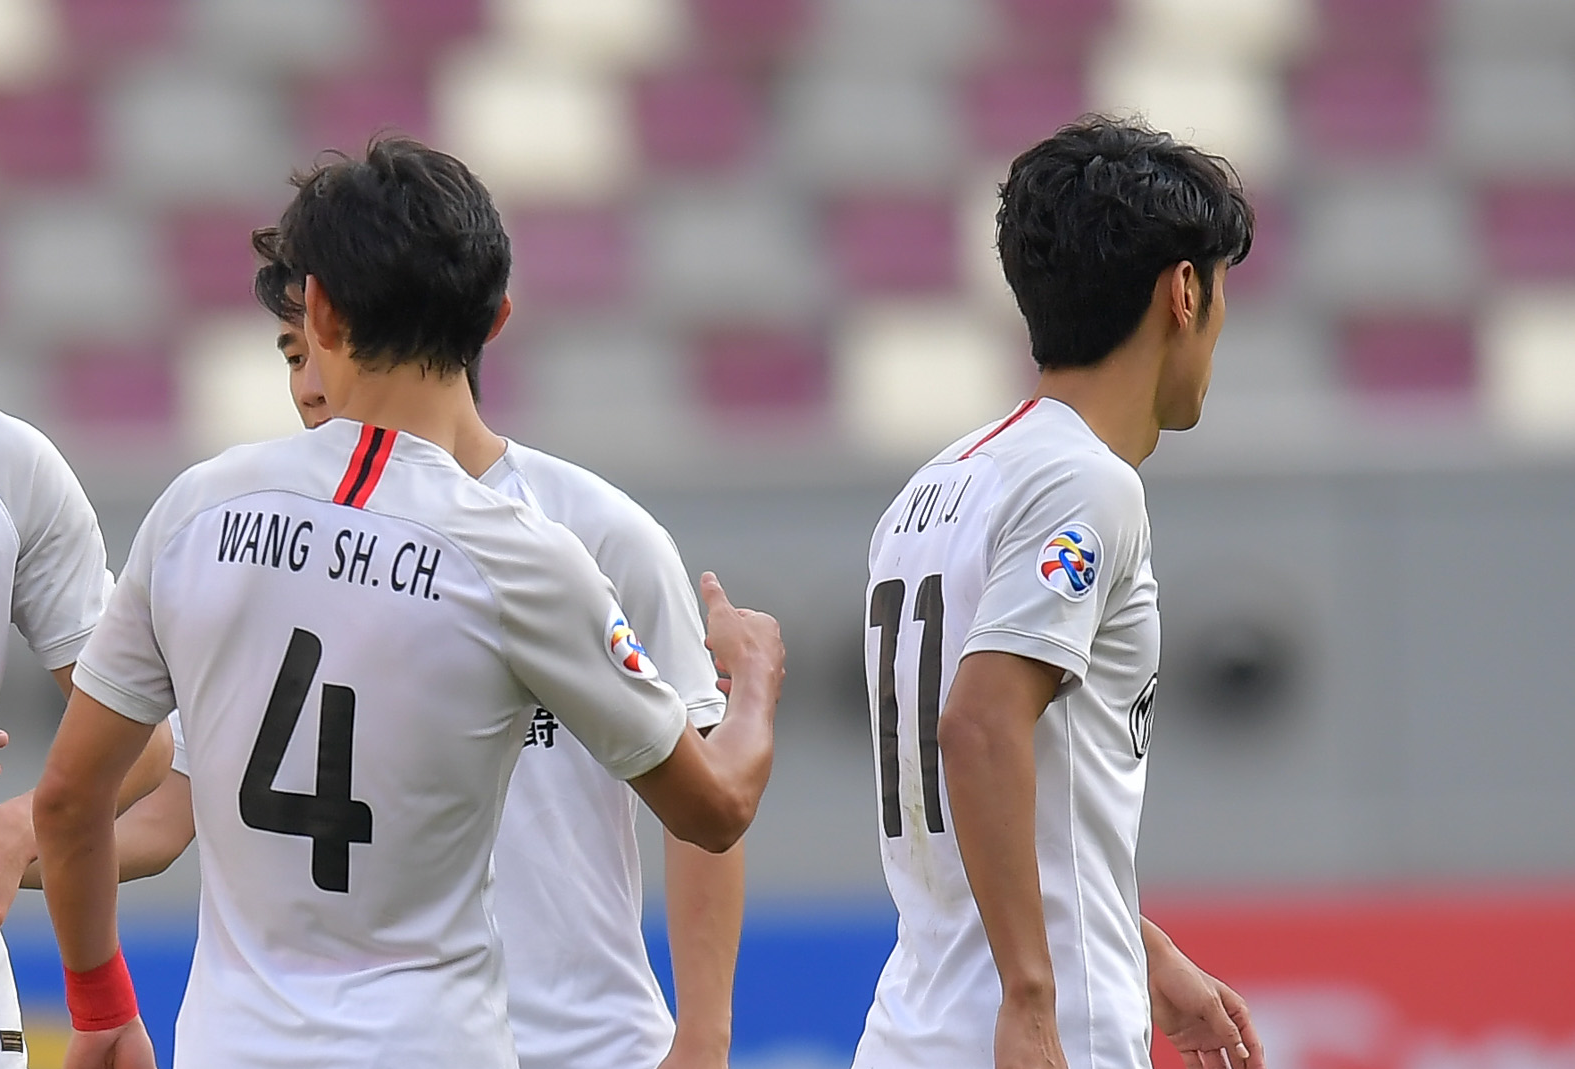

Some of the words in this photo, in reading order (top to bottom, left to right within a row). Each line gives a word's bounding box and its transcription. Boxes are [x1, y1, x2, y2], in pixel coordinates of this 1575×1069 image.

[217, 510, 314, 572] WANG
[239, 627, 373, 893] 4
[869, 573, 945, 838] 11
